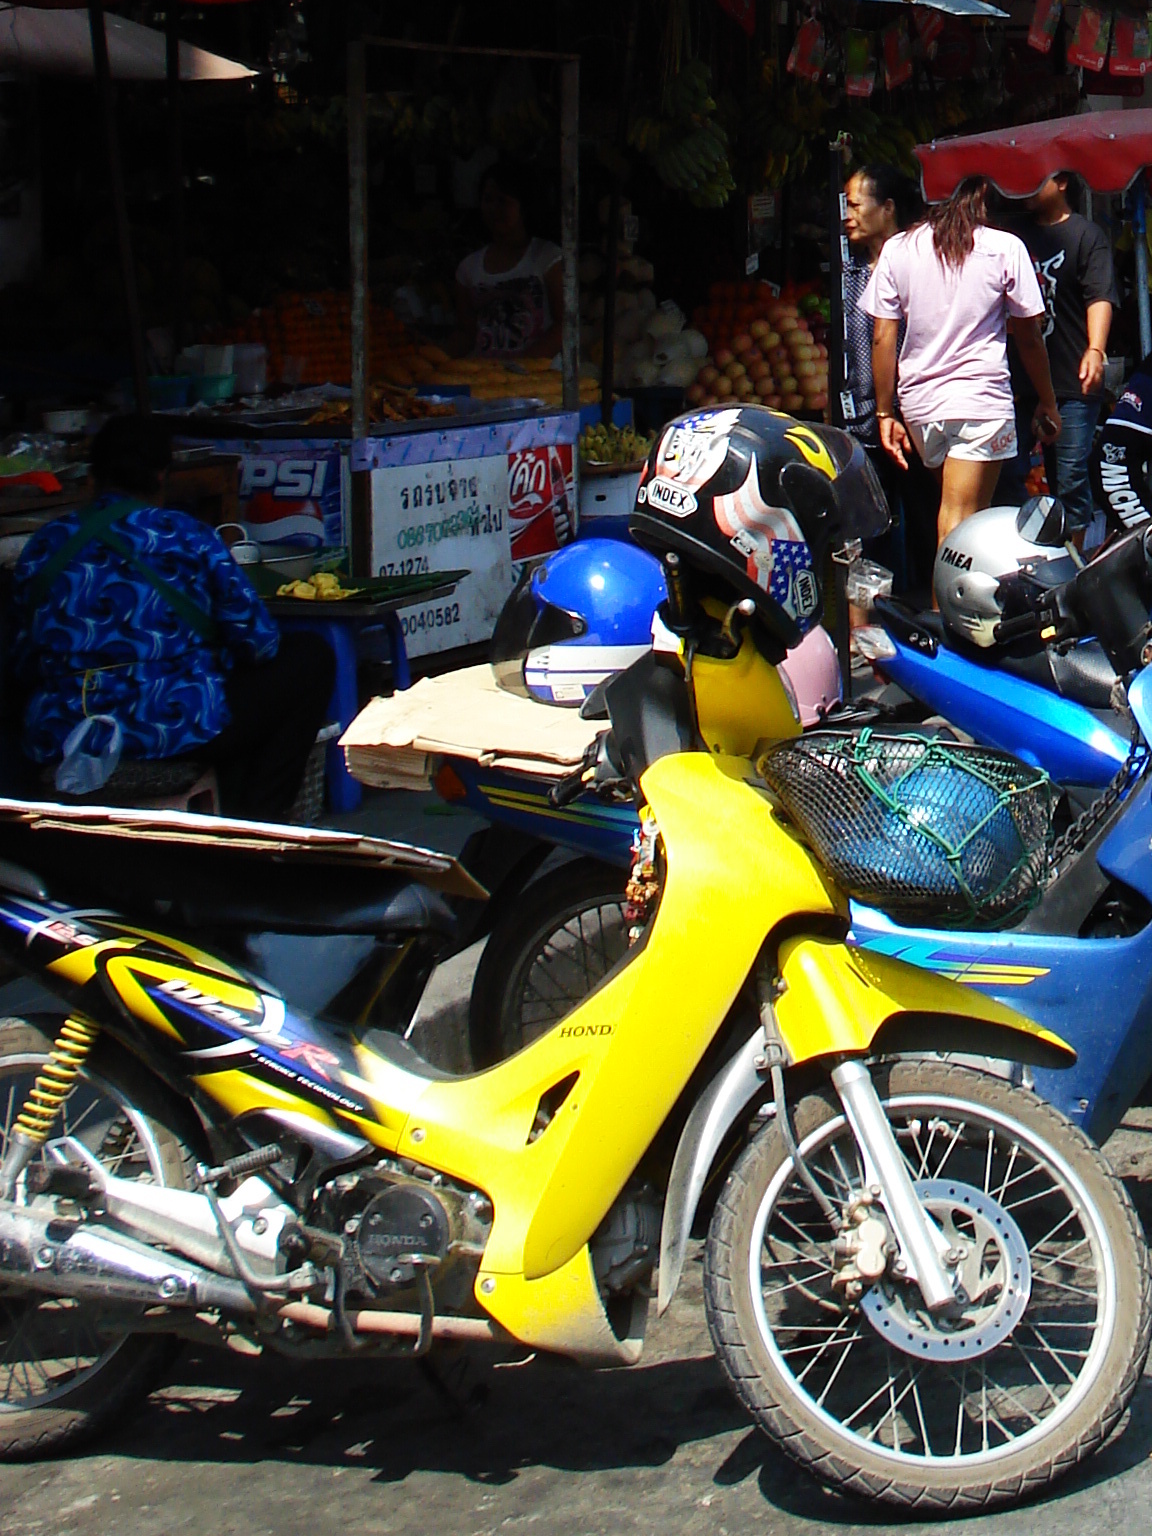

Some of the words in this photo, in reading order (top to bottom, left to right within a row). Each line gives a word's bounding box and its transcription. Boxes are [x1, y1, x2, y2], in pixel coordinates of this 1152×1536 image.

[239, 459, 329, 498] PSI
[651, 482, 688, 510] INDEX
[798, 575, 815, 612] INDEX
